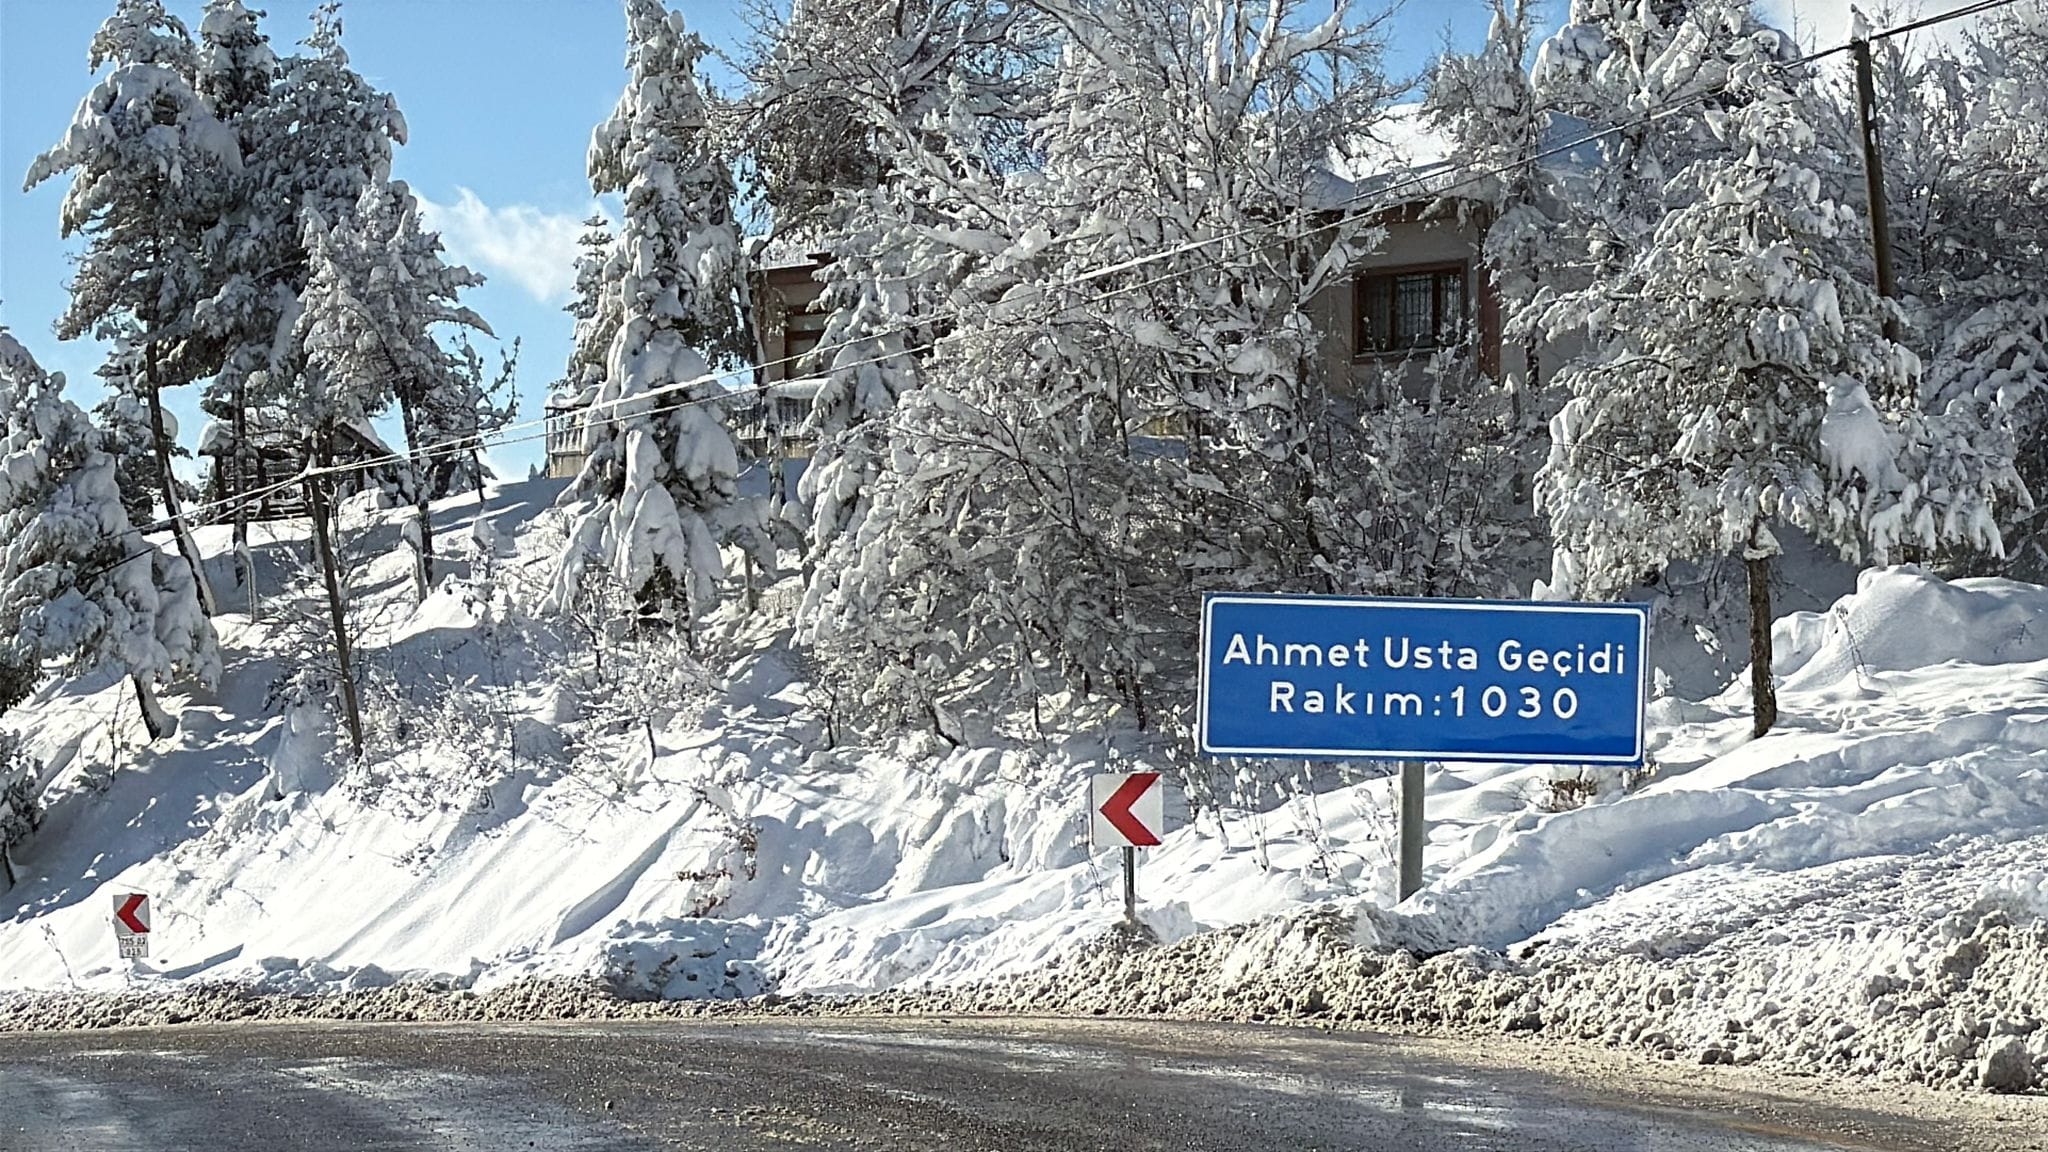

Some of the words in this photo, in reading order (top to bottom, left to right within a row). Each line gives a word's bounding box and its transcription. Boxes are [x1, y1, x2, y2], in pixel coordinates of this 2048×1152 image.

[1223, 633, 1370, 668] Ahmet
[1384, 636, 1478, 670] Usta
[1498, 639, 1624, 678] Geçidi
